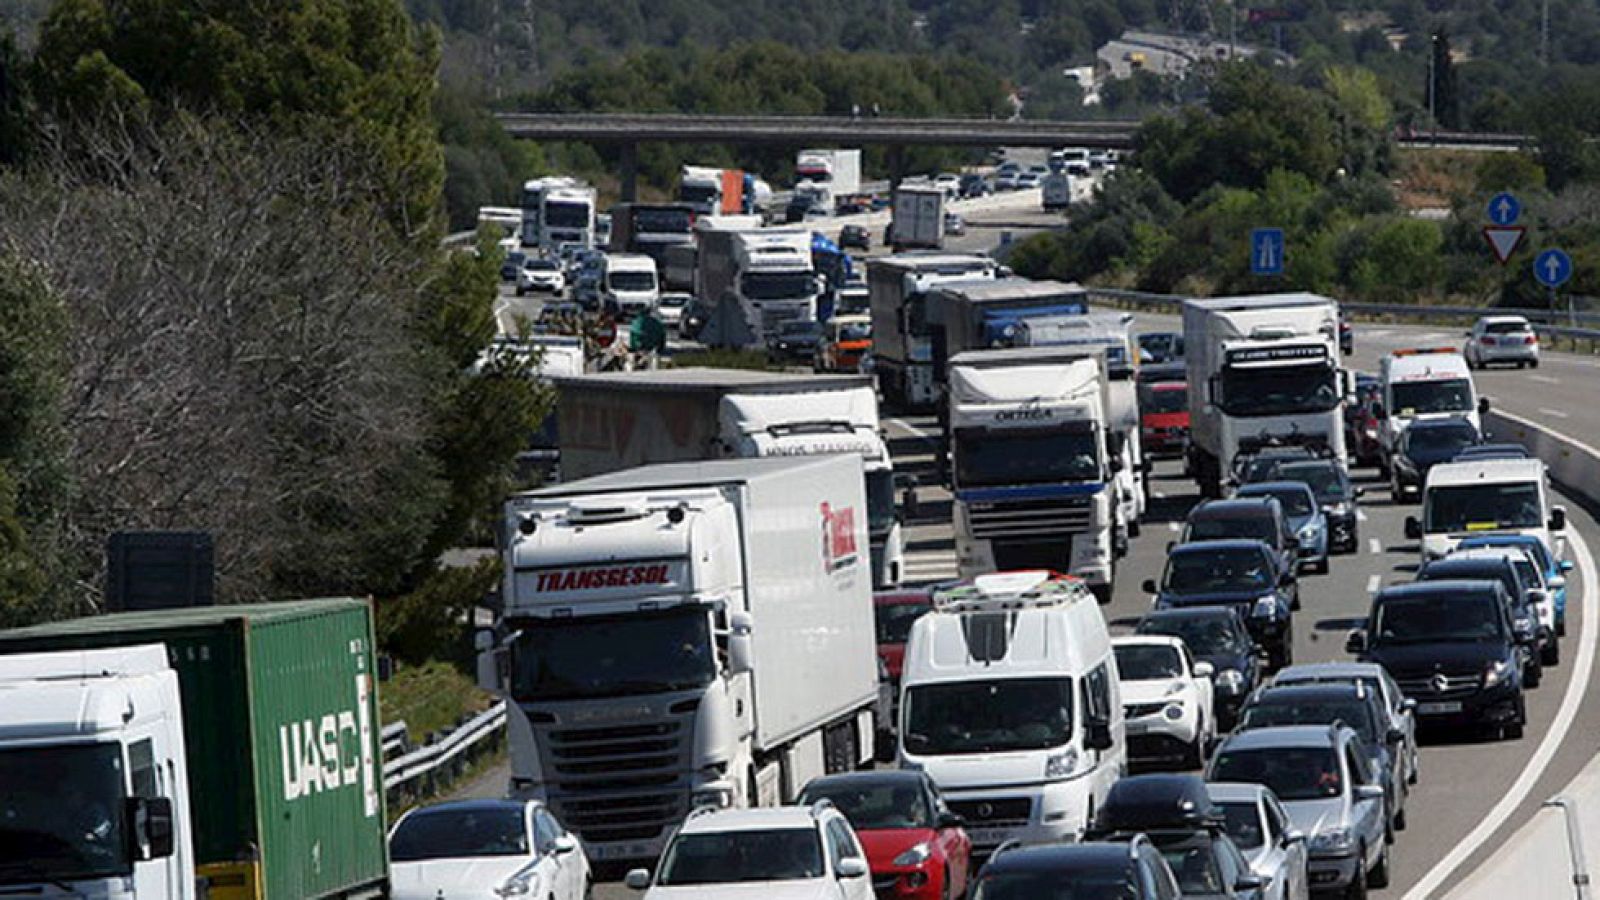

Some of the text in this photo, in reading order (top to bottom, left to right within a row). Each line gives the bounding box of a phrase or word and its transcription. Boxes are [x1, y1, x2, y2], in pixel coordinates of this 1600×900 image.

[994, 408, 1053, 421] ORTEGA
[536, 564, 669, 592] TRANSGESOL
[280, 711, 359, 800] UASC
